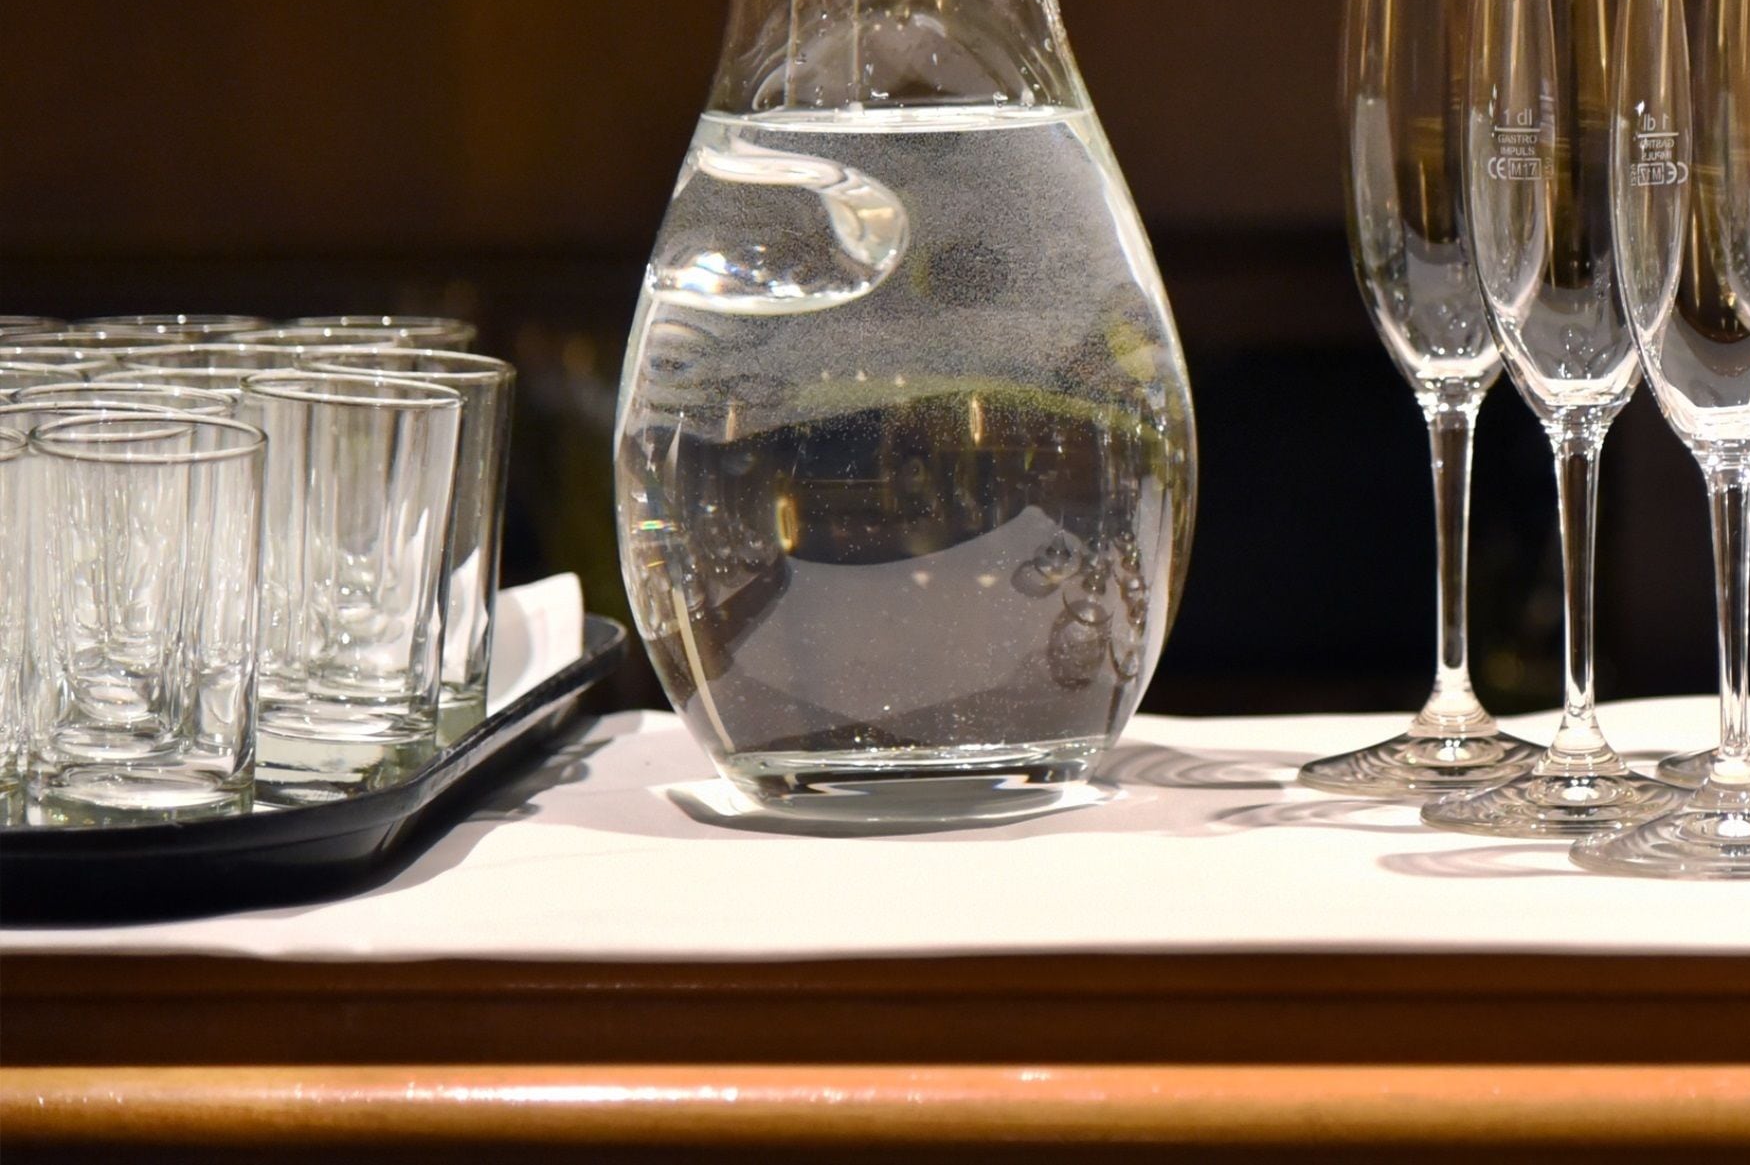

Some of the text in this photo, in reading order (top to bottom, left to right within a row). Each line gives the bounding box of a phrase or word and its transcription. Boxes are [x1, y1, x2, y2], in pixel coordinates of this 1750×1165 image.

[1503, 108, 1533, 126] 1 dl
[1497, 134, 1538, 145] GASTRO
[1500, 146, 1535, 157] IMPULS
